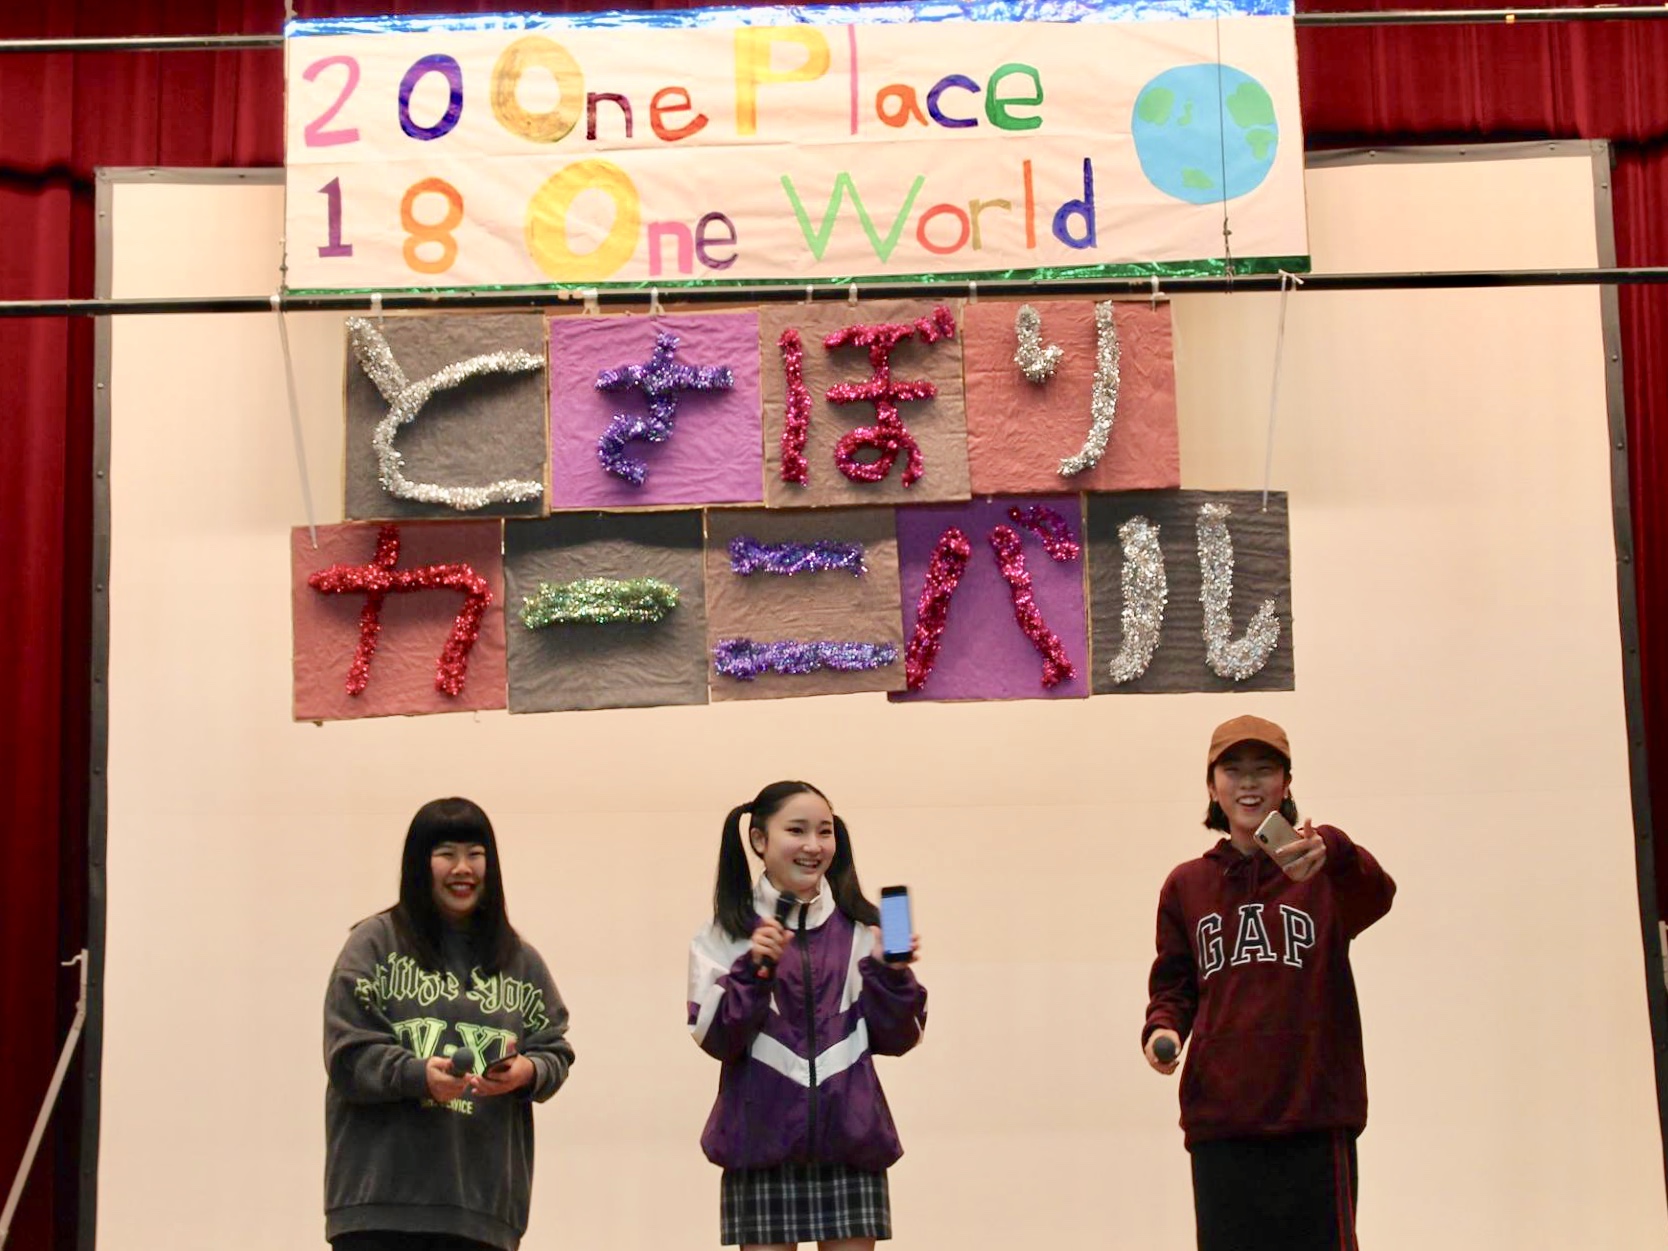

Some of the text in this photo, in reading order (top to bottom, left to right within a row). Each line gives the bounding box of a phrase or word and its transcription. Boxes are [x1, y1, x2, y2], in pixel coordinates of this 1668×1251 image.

[490, 36, 709, 144] One
[734, 23, 1044, 137] Place
[523, 159, 738, 283] One
[780, 157, 1098, 263] World
[345, 300, 1121, 511] とさぼり
[308, 502, 1281, 697] カーニバル
[1196, 903, 1316, 981] GAP
